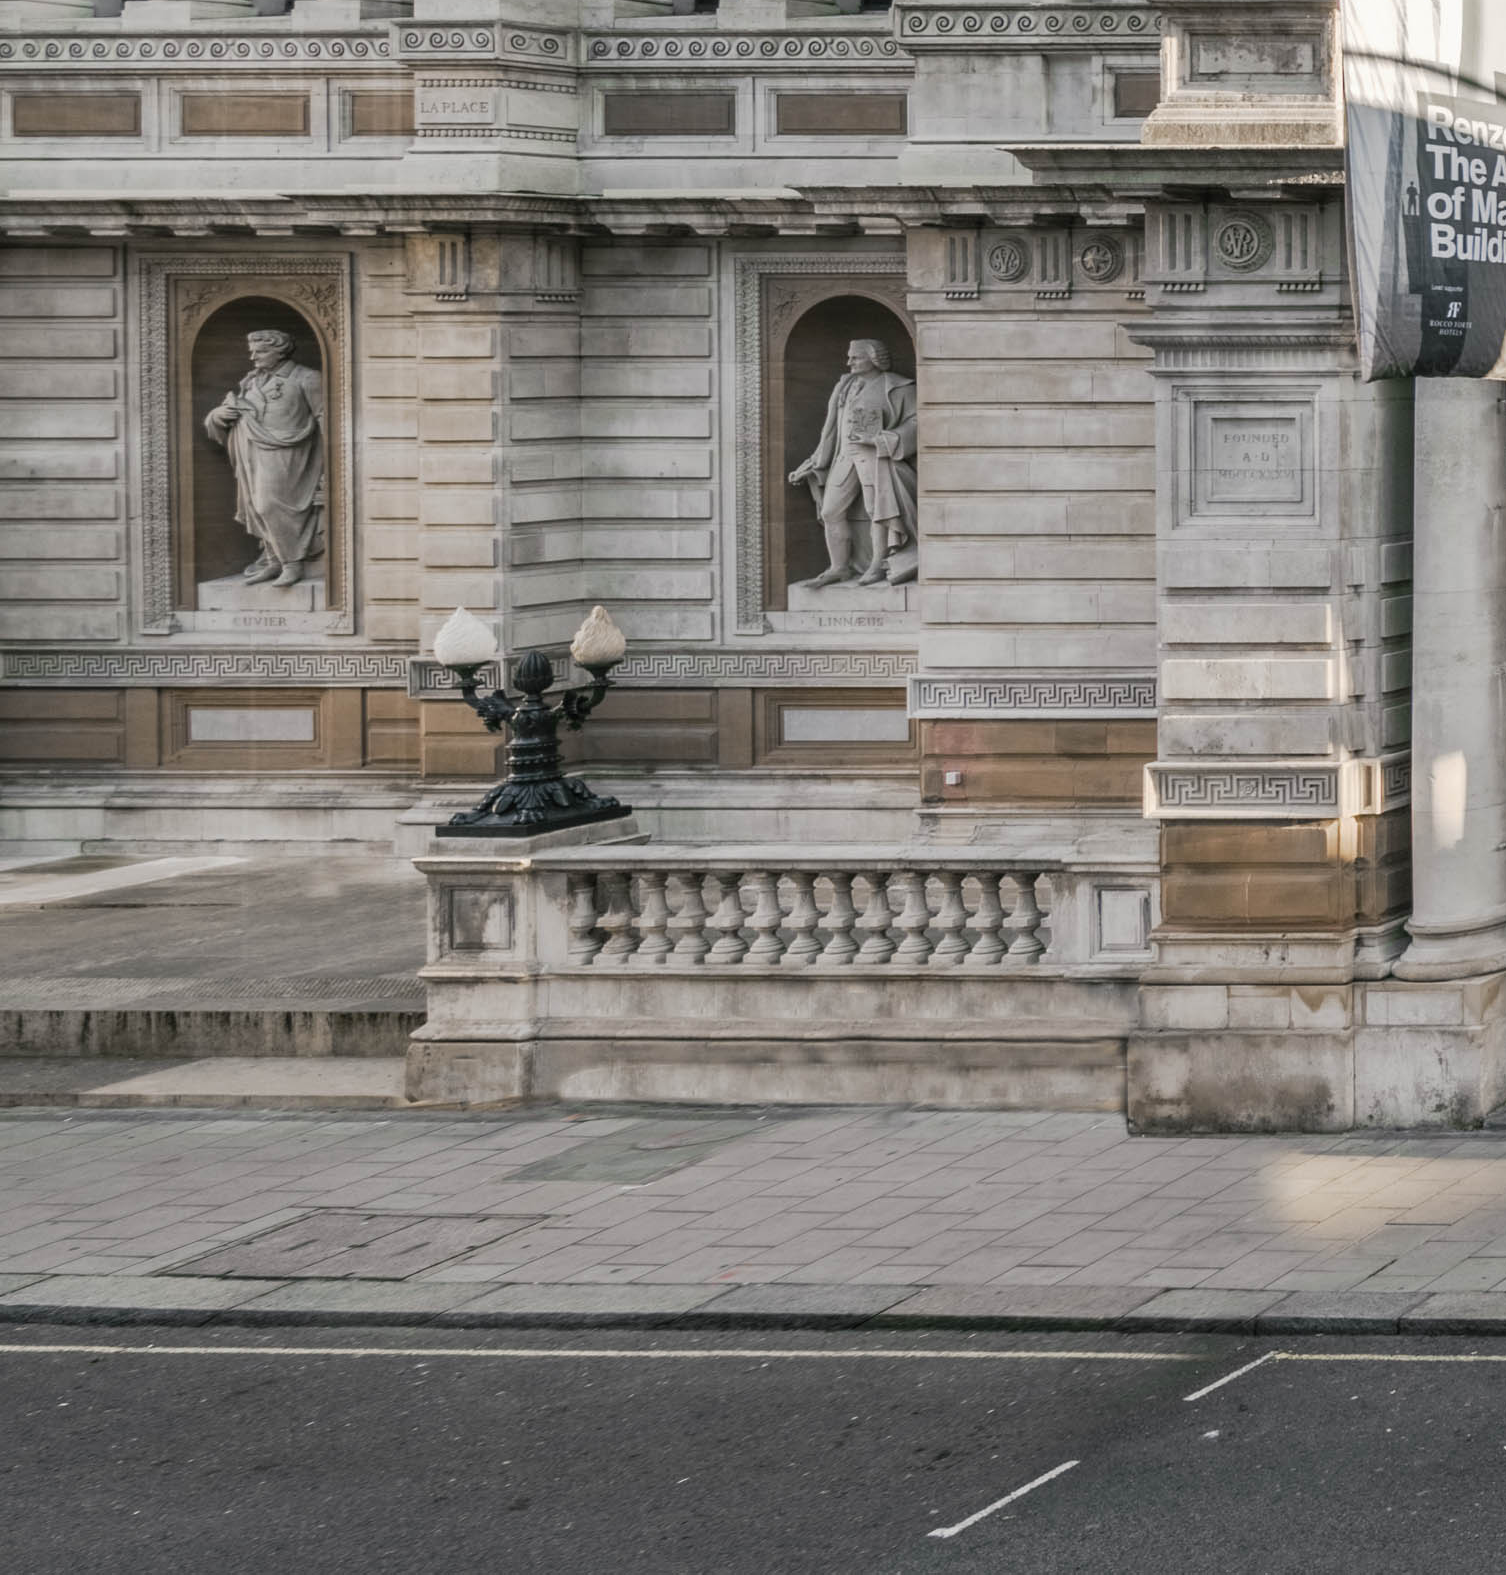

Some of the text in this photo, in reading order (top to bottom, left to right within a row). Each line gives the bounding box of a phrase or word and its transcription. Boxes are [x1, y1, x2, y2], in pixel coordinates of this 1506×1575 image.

[1425, 143, 1488, 186] The
[1427, 185, 1466, 221] of
[1224, 433, 1289, 443] FOUNDED
[232, 616, 287, 627] CUVIER
